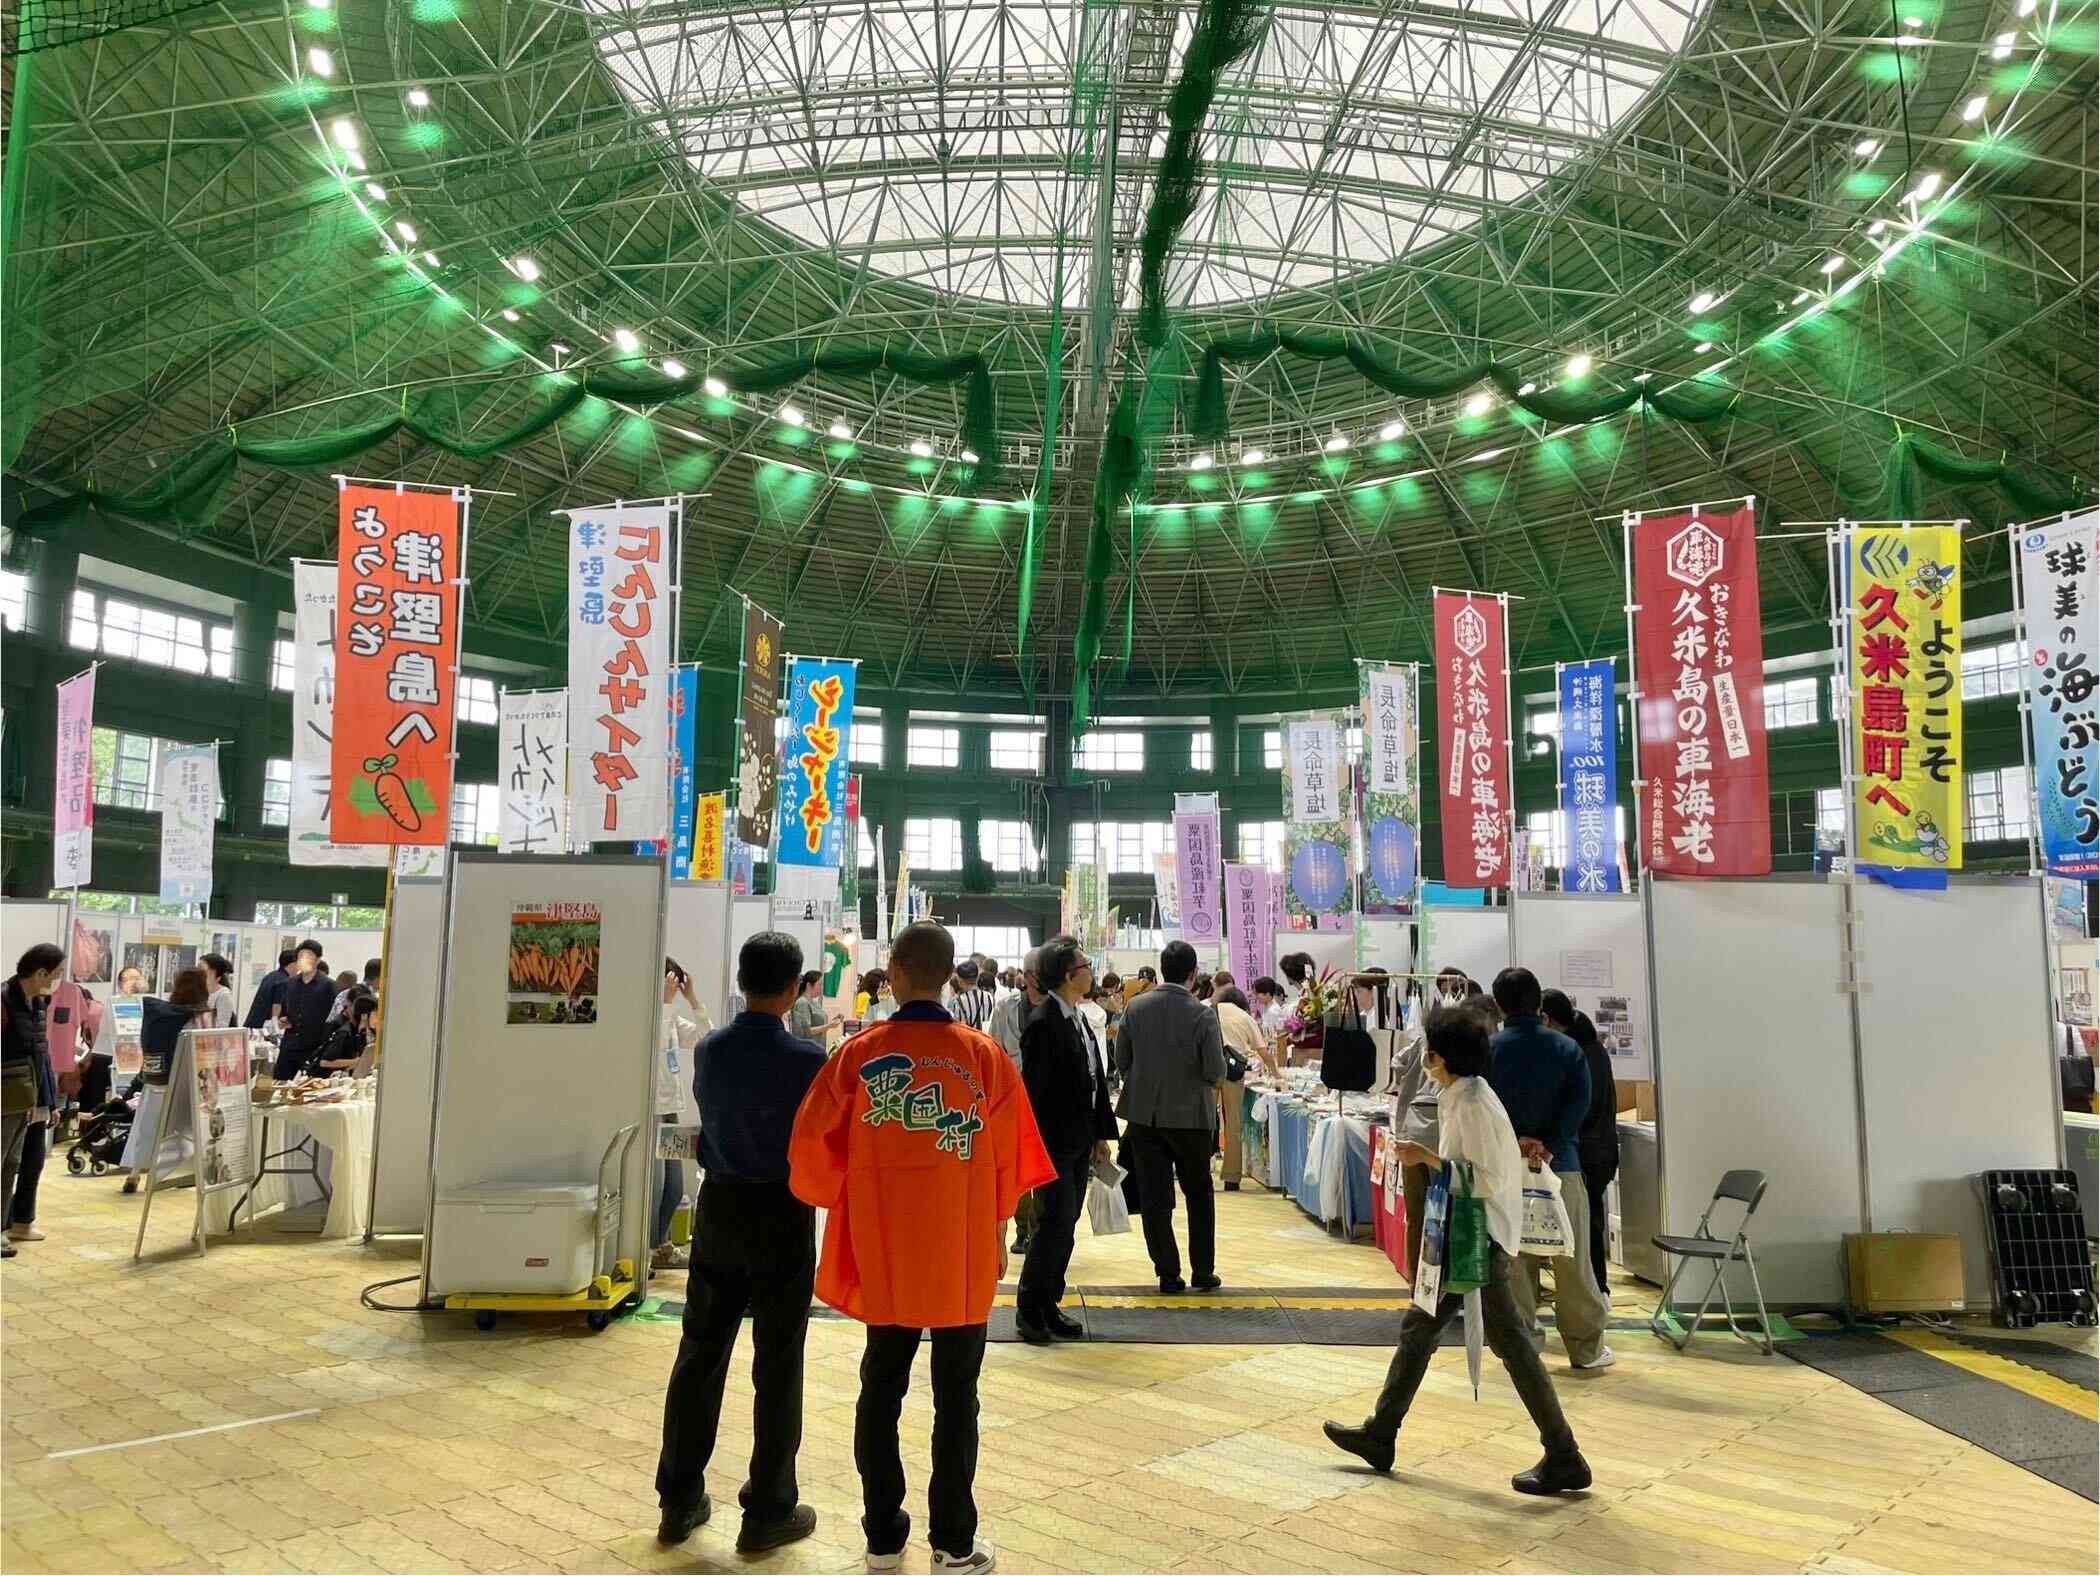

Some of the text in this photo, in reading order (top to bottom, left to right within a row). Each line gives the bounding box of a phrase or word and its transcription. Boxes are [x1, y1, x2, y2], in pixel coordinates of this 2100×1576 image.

[1708, 582, 1733, 669] おきなわ
[1858, 582, 1911, 818] 久米島町へ
[1919, 619, 1957, 784] ようこそ
[1671, 588, 1715, 864] 久米島の車海老
[859, 1053, 984, 1160] 粟国村
